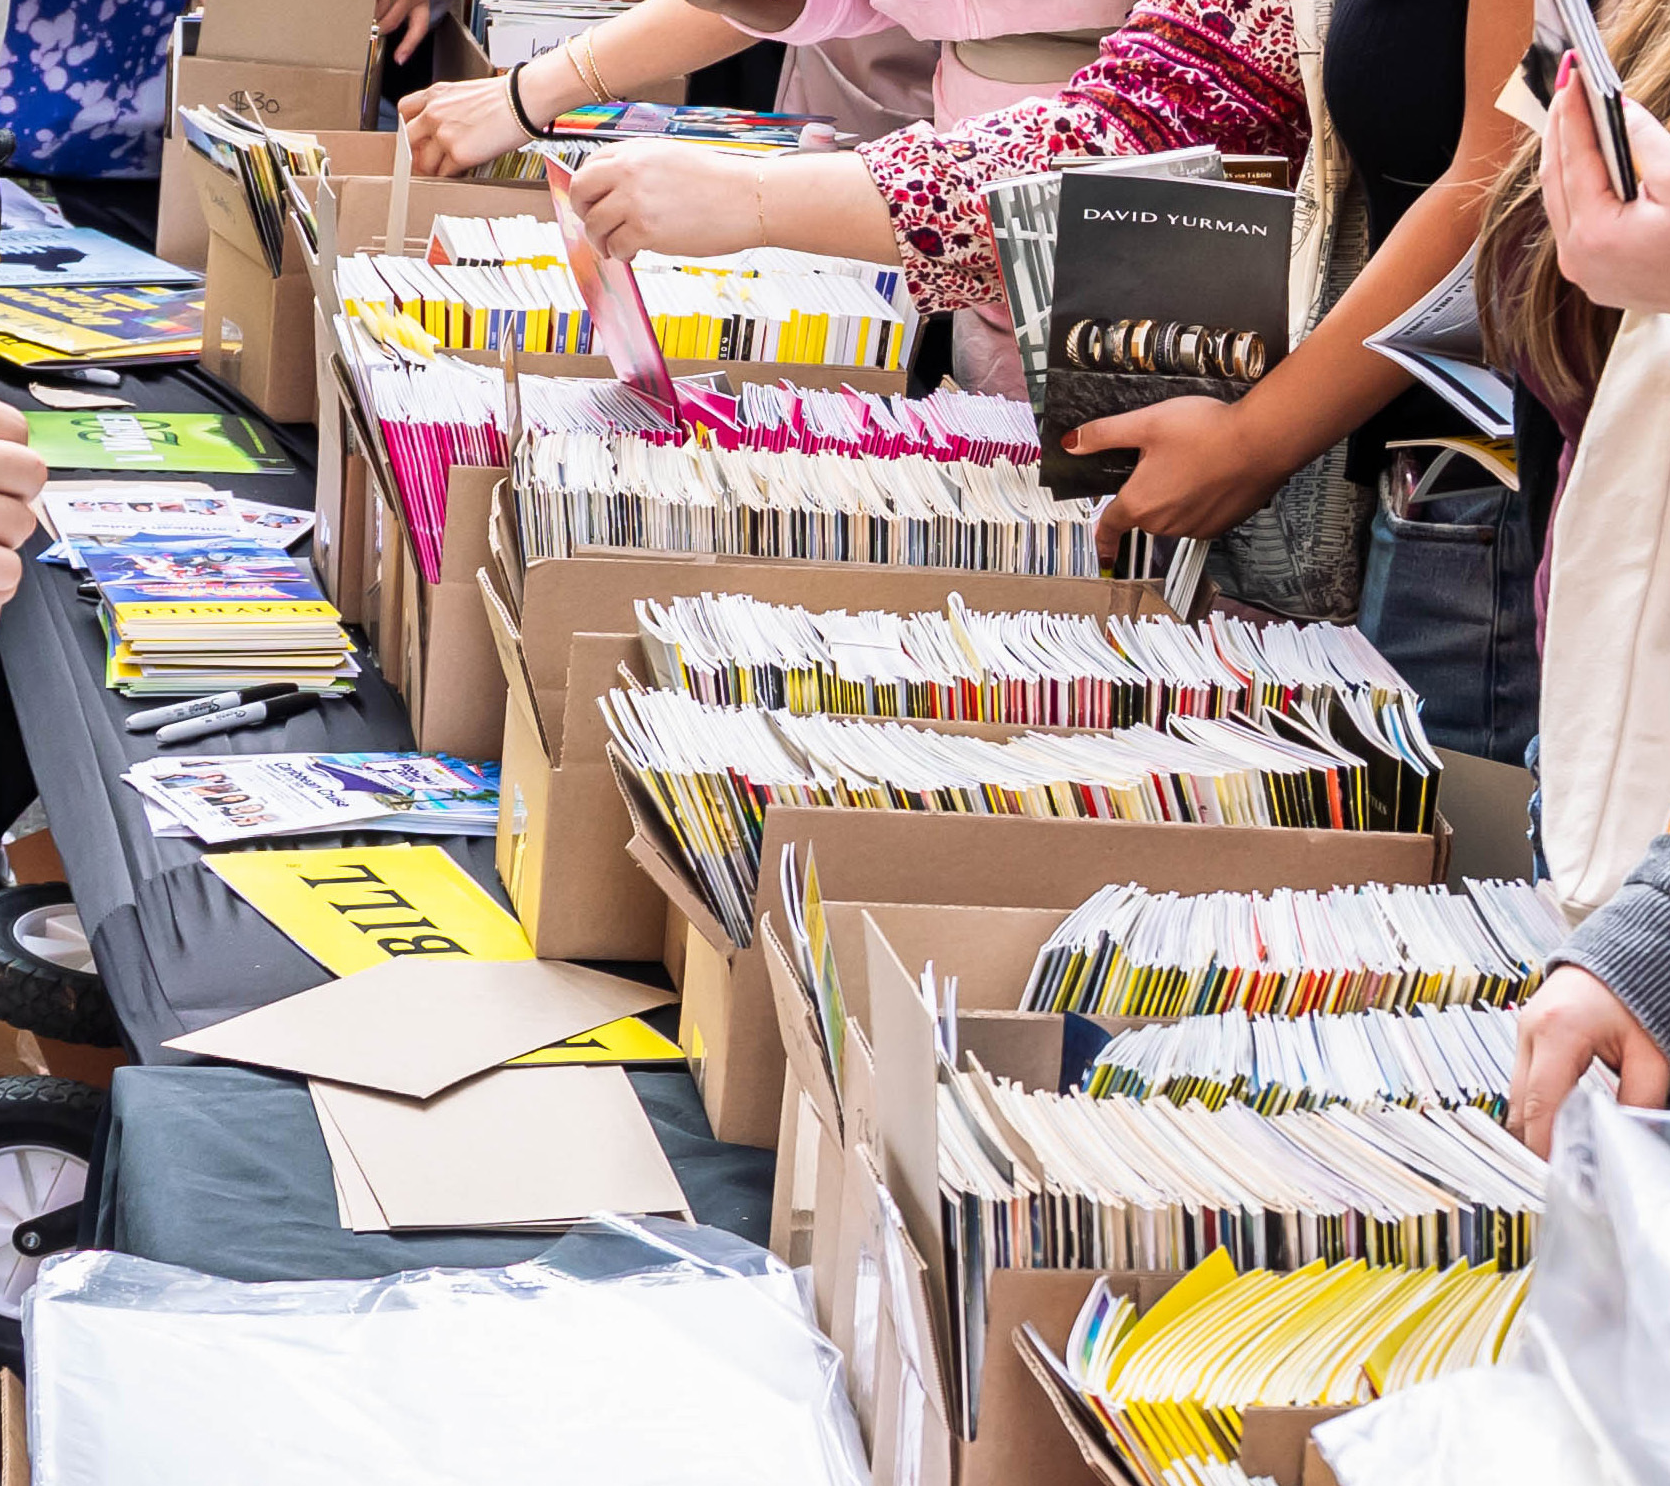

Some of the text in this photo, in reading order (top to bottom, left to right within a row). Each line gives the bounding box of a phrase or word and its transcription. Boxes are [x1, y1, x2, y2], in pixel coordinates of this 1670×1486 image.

[228, 90, 281, 114] $30
[1083, 207, 1269, 238] DAVID YURMAN
[129, 606, 324, 615] PLAYBILL
